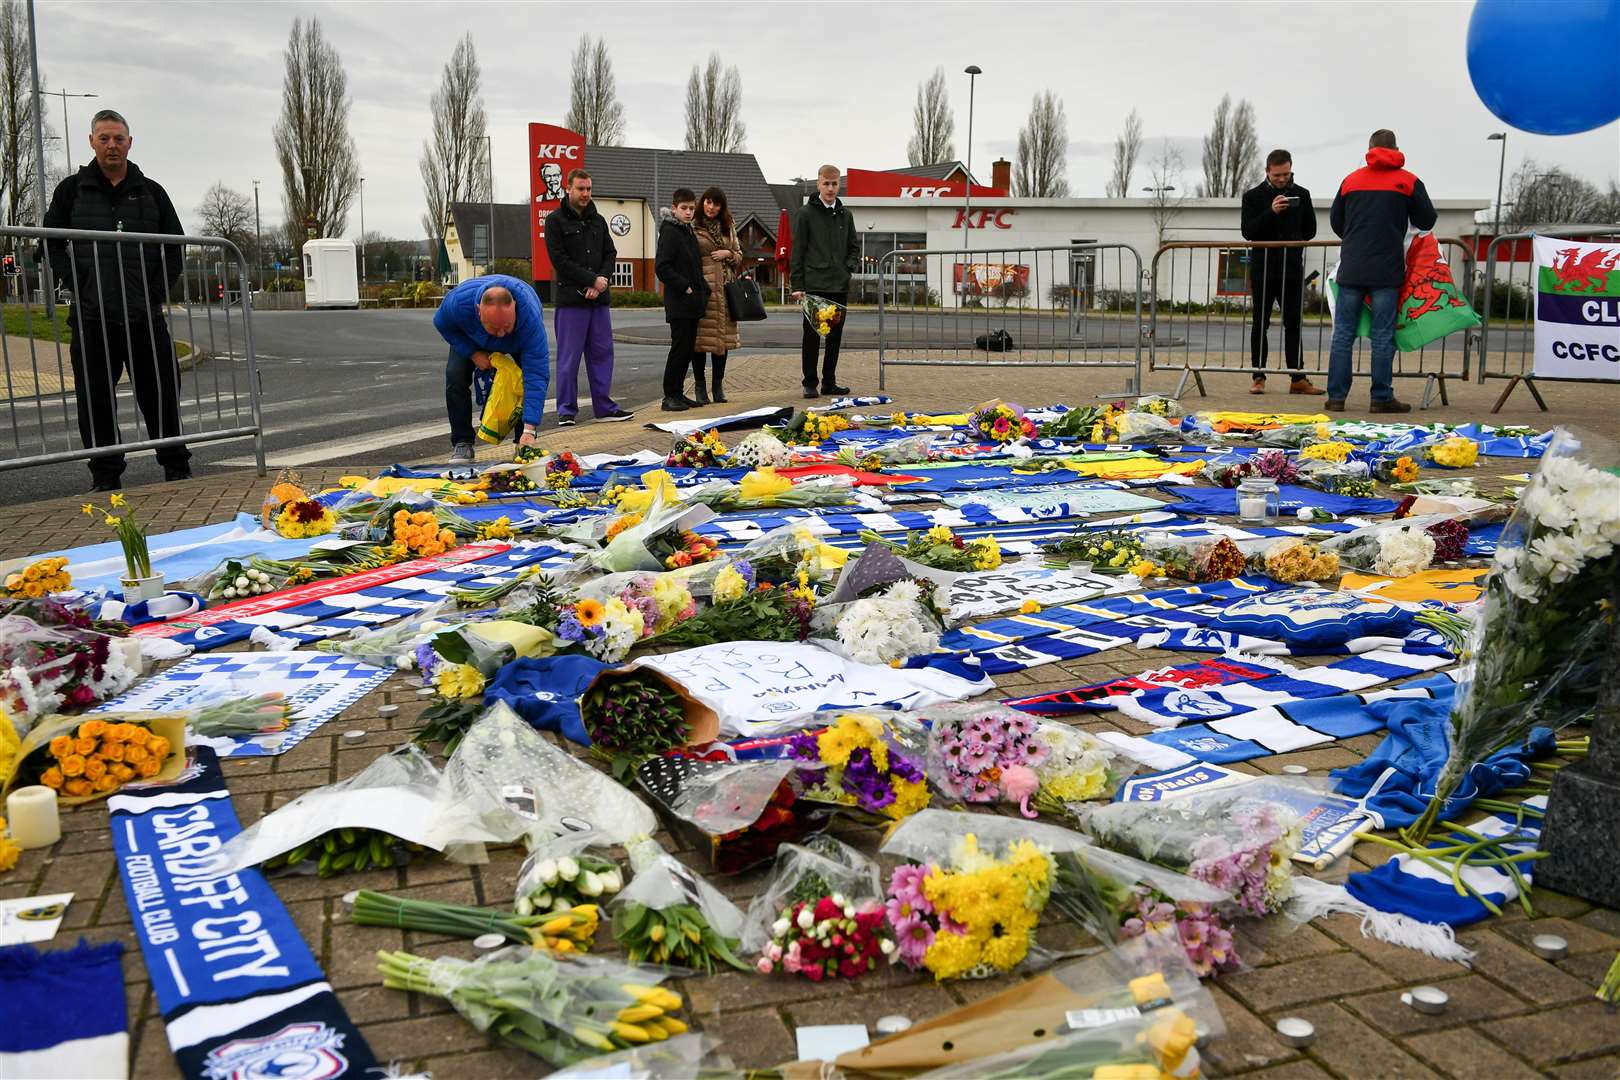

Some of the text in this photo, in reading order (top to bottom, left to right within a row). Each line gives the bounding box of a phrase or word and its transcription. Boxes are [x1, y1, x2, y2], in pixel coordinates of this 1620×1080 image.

[537, 143, 580, 160] KFC
[899, 186, 951, 199] KFC
[951, 207, 1018, 229] KFC
[1582, 300, 1620, 323] CL
[1151, 771, 1210, 791] SUPER
[151, 804, 249, 910] CARDIFF
[124, 854, 181, 945] FOOTBALL CLUB
[191, 910, 291, 982] CITY
